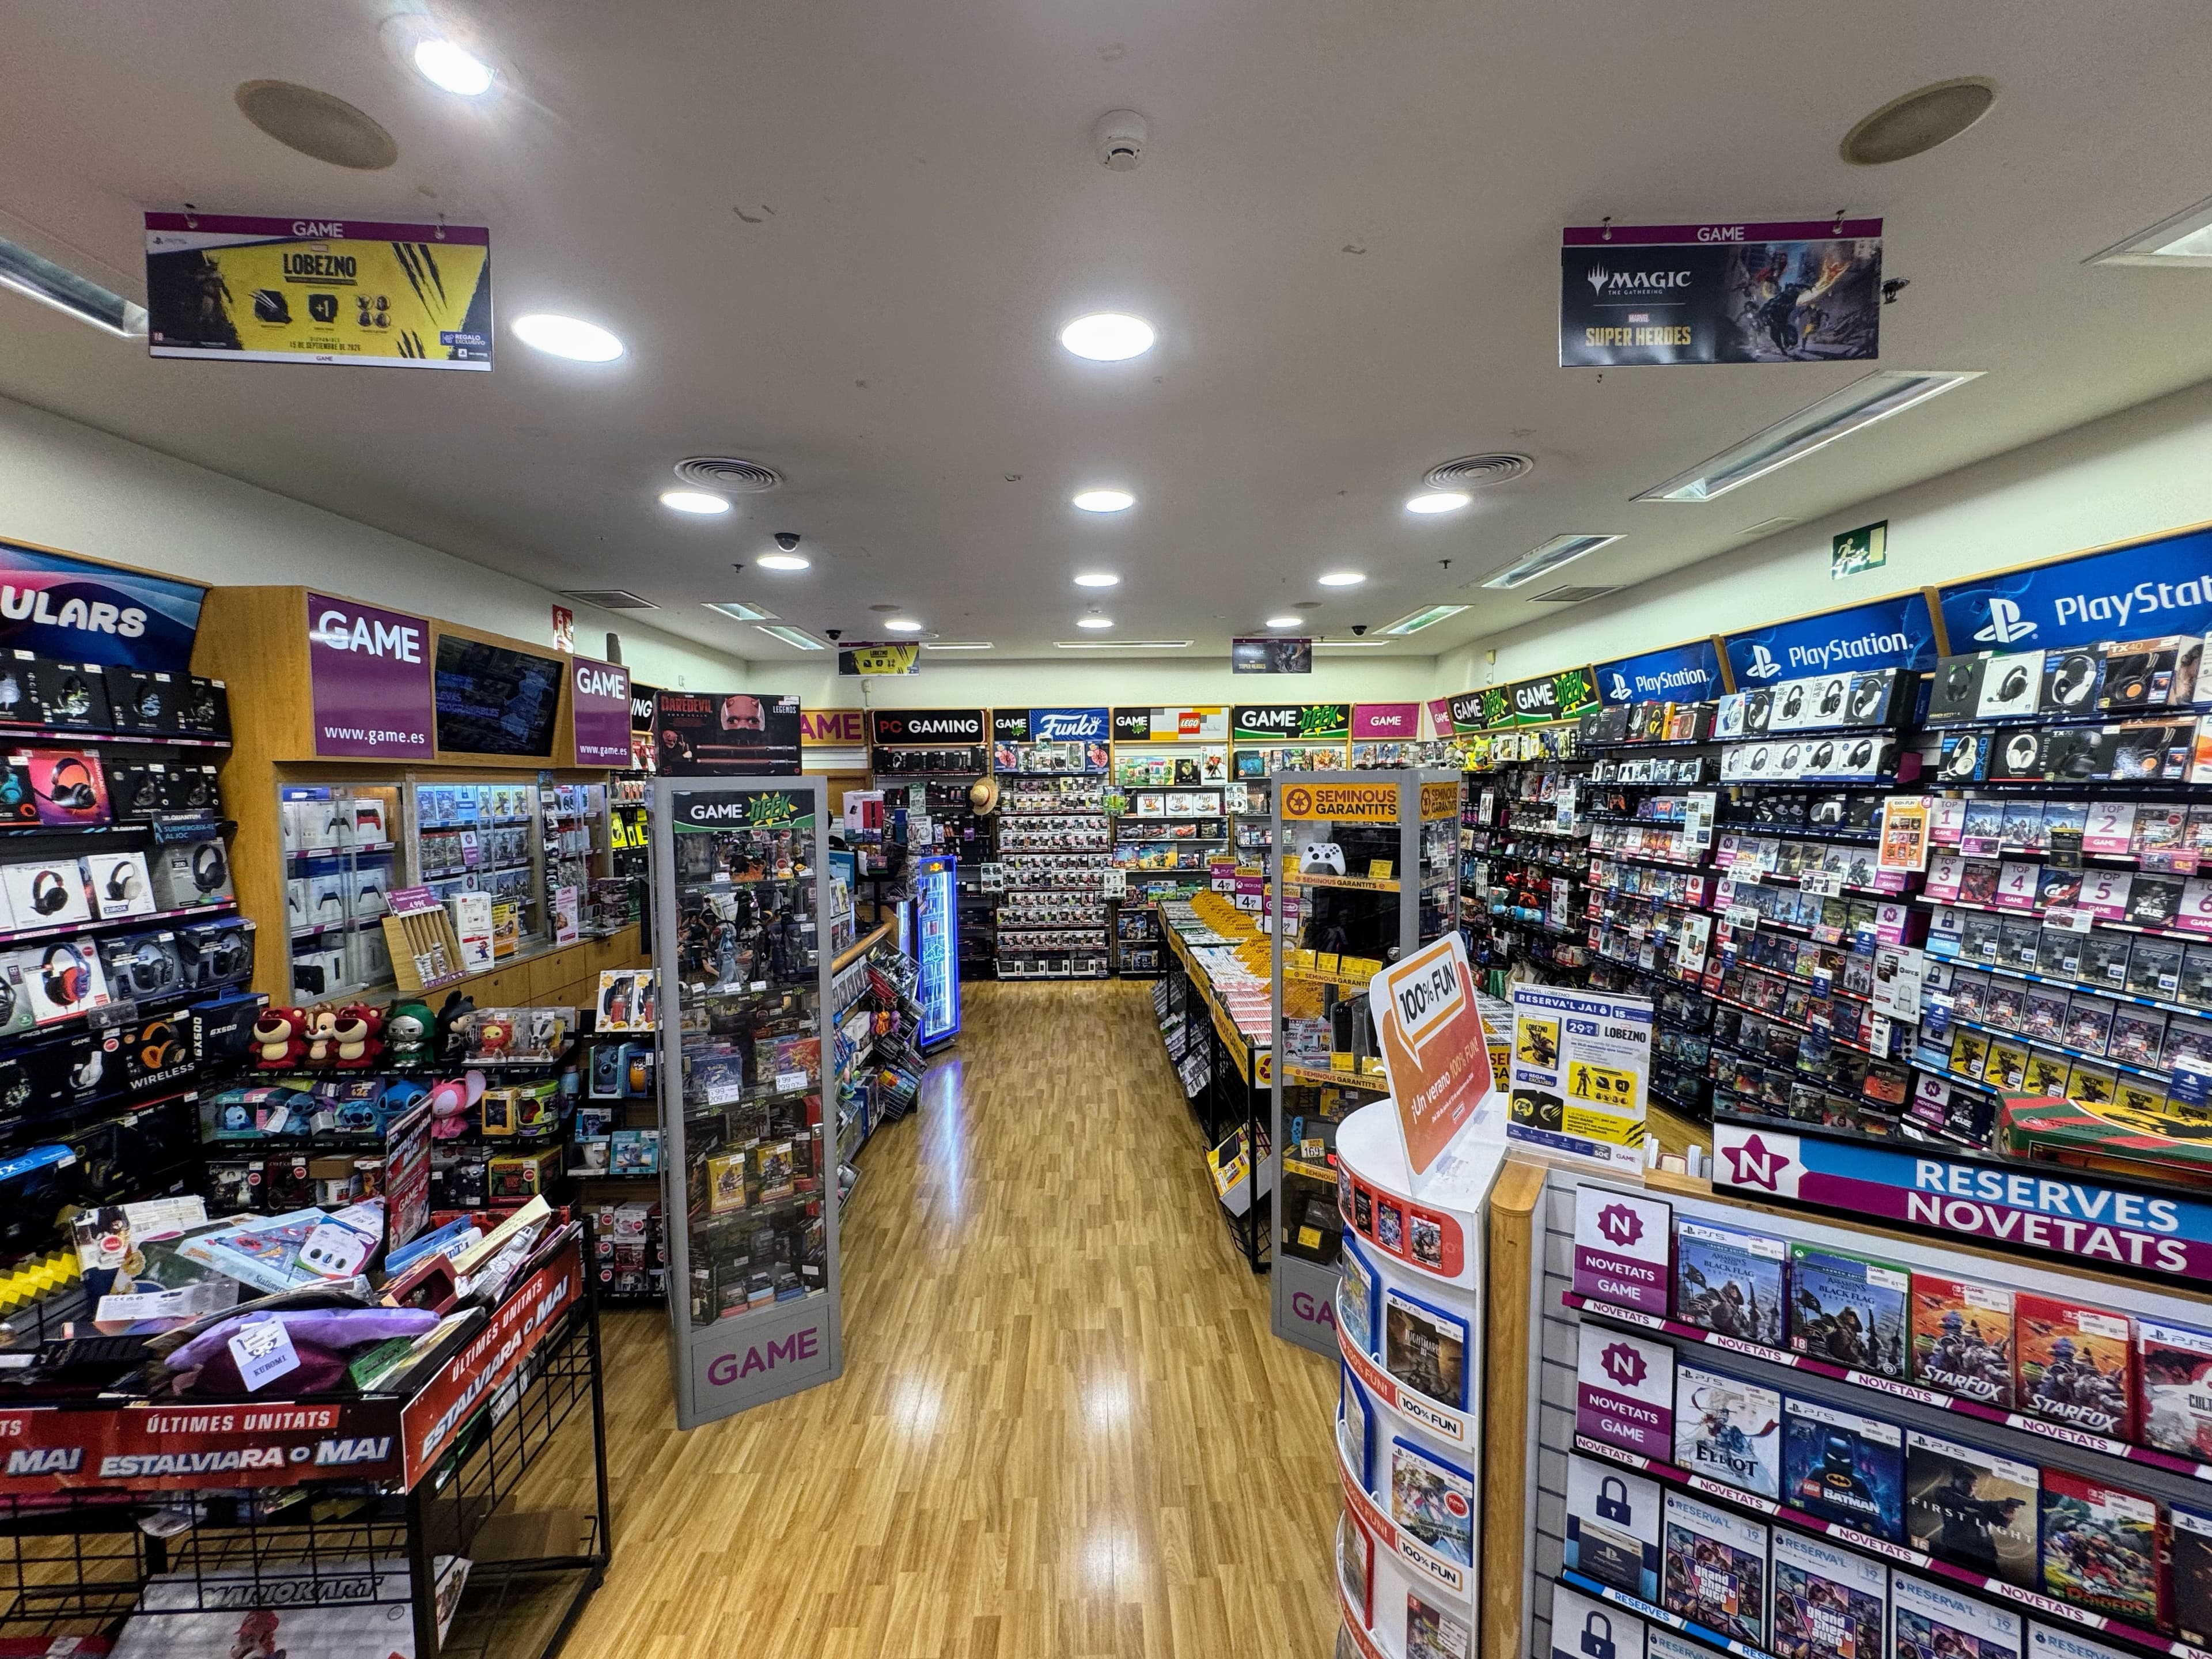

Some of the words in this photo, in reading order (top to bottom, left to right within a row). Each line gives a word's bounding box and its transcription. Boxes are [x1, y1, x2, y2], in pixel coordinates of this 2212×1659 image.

[293, 221, 343, 237] GAME
[1697, 226, 1745, 242] GAME
[283, 253, 357, 278] LOBEZNO
[1607, 271, 1692, 288] MAGIC
[1586, 327, 1631, 346] SUPER
[1635, 326, 1691, 346] HEROES
[319, 611, 421, 664] GAME
[1788, 630, 1913, 669] PlayStation
[577, 667, 625, 700] GAME
[1636, 668, 1709, 692] PlayStation
[1516, 683, 1554, 709] GAME
[1556, 671, 1586, 706] GEEK
[661, 695, 713, 713] DAREDEVIL
[773, 706, 796, 714] LEGENDS
[1453, 695, 1482, 720] GAME
[1483, 689, 1505, 717] GEEK
[801, 713, 863, 740] AME
[880, 719, 902, 733] PC
[908, 719, 979, 734] GAMING
[995, 718, 1027, 729] GAME
[1040, 714, 1099, 737] Funko
[1116, 717, 1147, 727] GAME
[1179, 718, 1200, 728] LEGO
[1241, 710, 1296, 728] GAME
[1301, 705, 1340, 730] GEEK
[1370, 716, 1402, 726] GAME
[1434, 712, 1448, 722] GAME
[325, 727, 425, 744] www.game.es
[580, 744, 627, 756] www.game.es
[1316, 789, 1396, 803] SEMINOUS
[1941, 800, 1958, 808] TOP
[691, 804, 742, 819] GAME
[750, 794, 791, 821] GEEK
[1316, 802, 1396, 815] GARANTITS
[1942, 809, 1950, 825] 1
[2102, 805, 2124, 814] TOP
[2100, 816, 2117, 834] 2
[1940, 857, 1956, 865] TOP
[2012, 865, 2030, 874] TOP
[1303, 876, 1336, 885] SEMINOUS
[1337, 880, 1376, 889] GARANTITS
[1940, 866, 1950, 881] 3
[2097, 872, 2120, 881] TOP
[1933, 885, 1950, 893] GAME
[2010, 875, 2024, 892] 4
[2095, 882, 2111, 900] 5
[2005, 896, 2023, 904] GAME
[2088, 906, 2111, 915] GAME
[2135, 906, 2165, 919] MOUSE
[1305, 973, 1336, 983] SEMINOUS
[1338, 978, 1370, 987] GARANTIT
[1399, 983, 1434, 1024] 100%
[1432, 961, 1456, 1002] FUN
[1519, 994, 1575, 1010] RESERVA'L
[1578, 1003, 1596, 1013] JA!
[1615, 1010, 1626, 1018] 15
[1526, 1024, 1547, 1033] LOBEZNO
[1604, 1027, 1646, 1043] LOBEZNO
[71, 1037, 90, 1046] GAME
[130, 1063, 195, 1090] WIRELESS
[1304, 1070, 1336, 1081] SEMINOUS
[1337, 1077, 1376, 1089] GARANTITS
[1411, 1094, 1426, 1124] ¡Un
[1426, 1071, 1450, 1104] verano
[1450, 1052, 1466, 1078] 100%
[1465, 1036, 1479, 1062] FUN!
[1928, 1082, 1937, 1095] N
[1917, 1099, 1942, 1112] NOVETATS
[1919, 1108, 1936, 1118] GAME
[1594, 1150, 1609, 1159] 50€
[1616, 1154, 1635, 1162] GAME
[1305, 1169, 1336, 1181] SEMINOUS
[1739, 1150, 1770, 1183] N
[1916, 1158, 2179, 1232] RESERVES
[1610, 1213, 1630, 1237] N
[1907, 1192, 2187, 1272] NOVETATS
[1698, 1230, 1726, 1240] PS5
[1585, 1255, 1656, 1282] NOVETATS
[1704, 1260, 1730, 1272] BLACK
[1732, 1267, 1755, 1278] FLAG
[1597, 1280, 1641, 1301] GAME
[1819, 1284, 1848, 1297] BLACK
[1850, 1292, 1875, 1304] FLAG
[1965, 1286, 1984, 1295] GAME
[534, 1275, 569, 1327] MAI
[1293, 1292, 1336, 1330] GA
[1593, 1302, 1650, 1325] NOVETATS
[2080, 1312, 2101, 1321] GAME
[452, 1323, 499, 1381] ÚLTIMES
[503, 1277, 543, 1327] UNITATS
[1717, 1336, 1782, 1361] NOVETATS
[1792, 1338, 1806, 1350] 18
[707, 1327, 818, 1387] GAME
[1613, 1354, 1634, 1377] N
[1694, 1374, 1724, 1387] PS5
[1859, 1373, 1932, 1403] NOVETATS
[1921, 1364, 2005, 1403] STARFOX
[1402, 1397, 1429, 1420] 100%
[1431, 1414, 1457, 1434] FUN
[1589, 1393, 1658, 1425] NOVETATS
[1801, 1407, 1835, 1421] PS5
[2028, 1394, 2121, 1435] STARFOX
[146, 1414, 233, 1433] ÚLTIMES
[244, 1411, 330, 1430] UNITATS
[1601, 1418, 1644, 1443] GAME
[2023, 1419, 2108, 1450] NOVETATS
[99, 1447, 285, 1478] ESTALVIARA
[315, 1438, 392, 1465] MAI
[1577, 1437, 1633, 1464] NOVETATS
[1931, 1442, 1966, 1458] PS5
[6, 1447, 85, 1475] MAI
[1700, 1480, 1763, 1509] NOVETATS
[1824, 1488, 1880, 1514] BATMAN
[1911, 1497, 1967, 1520] FIRST
[1976, 1517, 2033, 1544] LIGHT
[1747, 1529, 1759, 1540] 19
[1839, 1528, 1912, 1561] NOVETATS
[1402, 1542, 1429, 1567] 100%
[1431, 1562, 1457, 1584] FUN
[1694, 1564, 1729, 1585] grand
[1699, 1574, 1736, 1599] theft
[1699, 1586, 1728, 1604] auto
[1615, 1592, 1670, 1622] RESERVES
[2001, 1584, 2084, 1621] NOVETATS
[1806, 1606, 1845, 1630] grand
[1812, 1628, 1843, 1647] auto
[1813, 1618, 1853, 1642] theft
